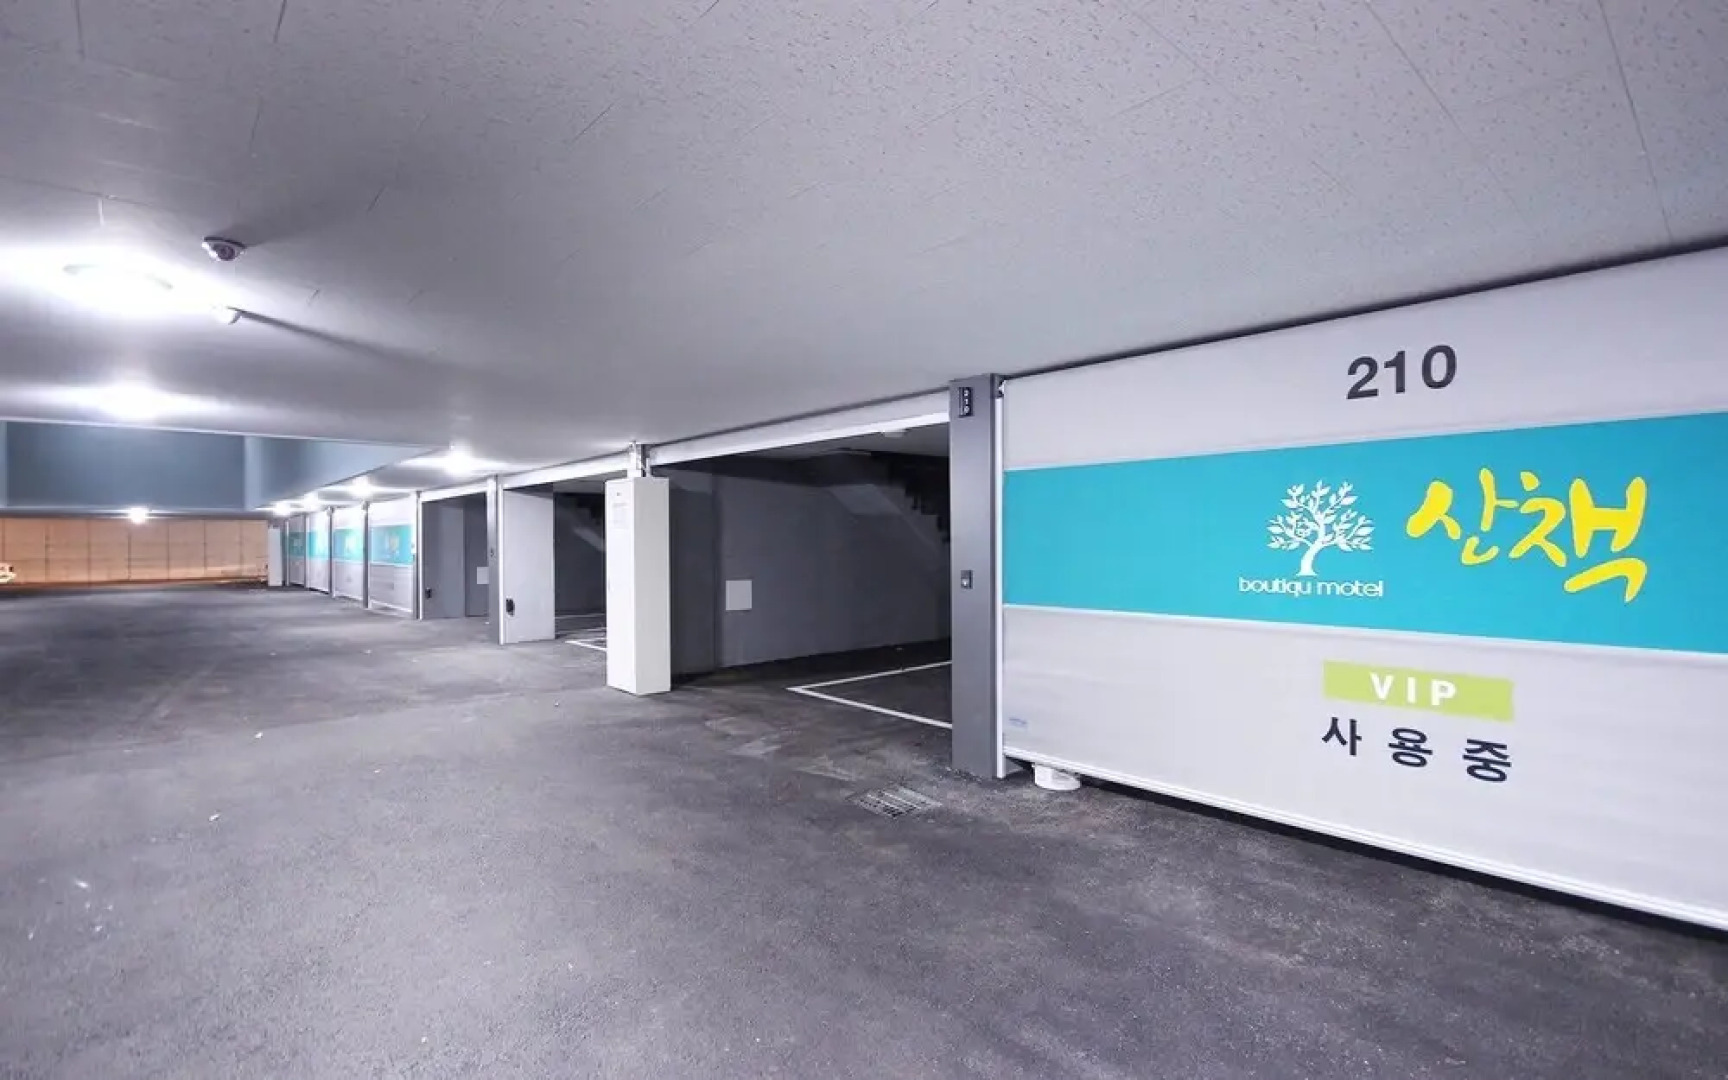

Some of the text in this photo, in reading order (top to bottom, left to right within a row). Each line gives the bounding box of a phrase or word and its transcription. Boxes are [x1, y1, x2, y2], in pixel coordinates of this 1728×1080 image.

[1346, 344, 1457, 399] 210
[1406, 467, 1648, 603] 산책
[1316, 580, 1384, 597] motel
[1370, 672, 1458, 707] VIP
